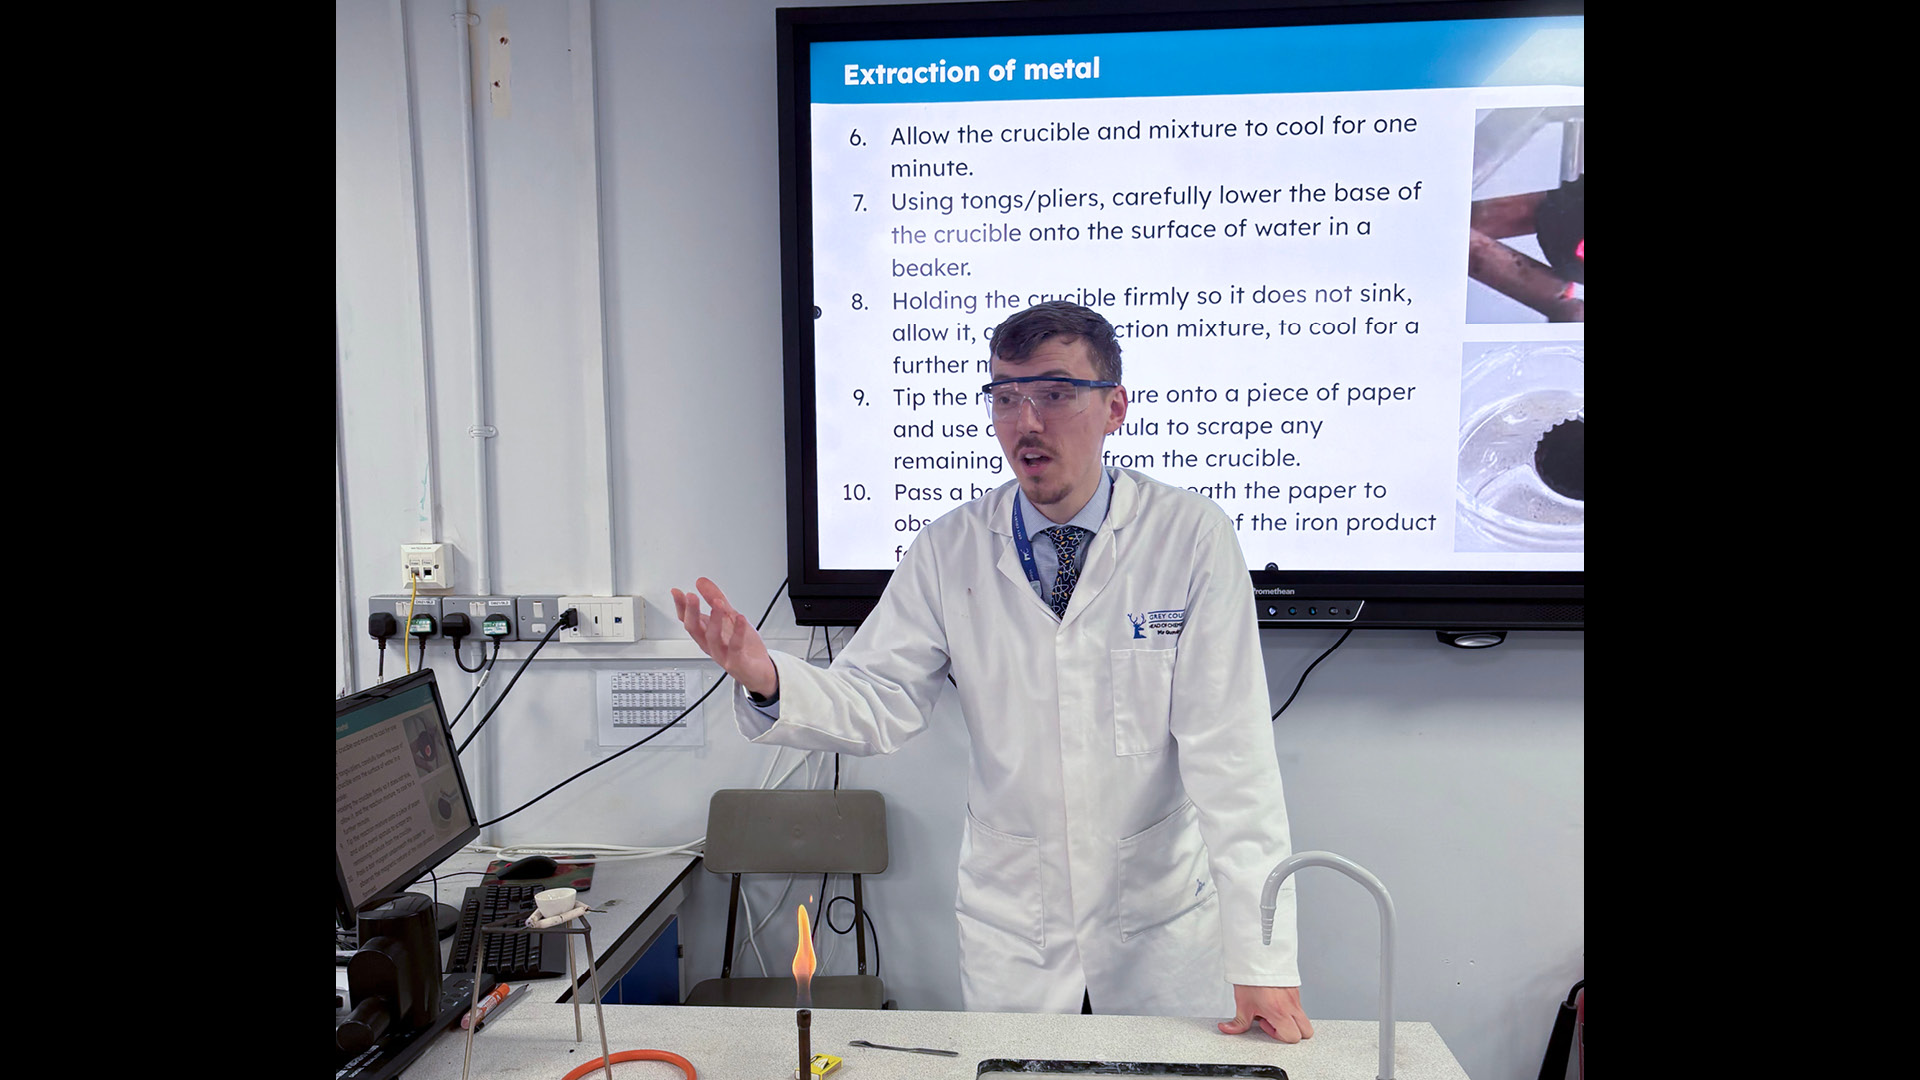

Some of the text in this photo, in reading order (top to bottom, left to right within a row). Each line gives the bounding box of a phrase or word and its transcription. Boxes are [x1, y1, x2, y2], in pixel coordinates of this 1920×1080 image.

[844, 56, 1100, 86] Extraction of metal
[849, 115, 1418, 147] 6. Allow the crucible and mixture to cool for one
[891, 158, 973, 178] minute.
[853, 180, 1422, 216] 7. Using tongs/pliers, carefully lower the base of
[891, 216, 1371, 244] the crucible onto the surface of water in a
[892, 258, 972, 277] beaker.
[852, 293, 868, 310] 8.
[894, 290, 976, 314] Holding
[985, 290, 1020, 308] the
[1124, 286, 1189, 310] firmly
[1198, 290, 1221, 304] so
[1230, 285, 1245, 304] it
[1253, 284, 1306, 303] does
[1315, 286, 1352, 302] not
[1361, 283, 1411, 305] sink,
[893, 322, 948, 341] allow
[957, 323, 976, 344] it,
[1113, 318, 1168, 339] ction
[1177, 318, 1271, 341] mixture,
[1279, 320, 1301, 336] to
[1310, 317, 1356, 335] cool
[1365, 316, 1397, 334] for
[1405, 321, 1419, 335] a
[893, 355, 969, 374] further
[853, 389, 869, 406] 9.
[893, 387, 925, 411] Tip
[933, 387, 967, 405] the
[1167, 385, 1217, 403] onto
[1226, 388, 1239, 403] a
[1248, 383, 1308, 408] piece
[1316, 383, 1340, 401] of
[1347, 387, 1416, 407] paper
[894, 420, 933, 437] and
[942, 423, 978, 437] use
[1107, 418, 1159, 436] tula
[1167, 419, 1190, 435] to
[1197, 421, 1272, 439] scrape
[1281, 421, 1323, 440] any
[894, 447, 1301, 475] remaining from the crucible.
[843, 484, 871, 501] 10.
[895, 484, 942, 501] Pass
[950, 487, 962, 501] a
[1244, 480, 1280, 499] the
[1288, 484, 1356, 504] paper
[1364, 482, 1387, 499] to
[1231, 512, 1436, 535] f the iron product
